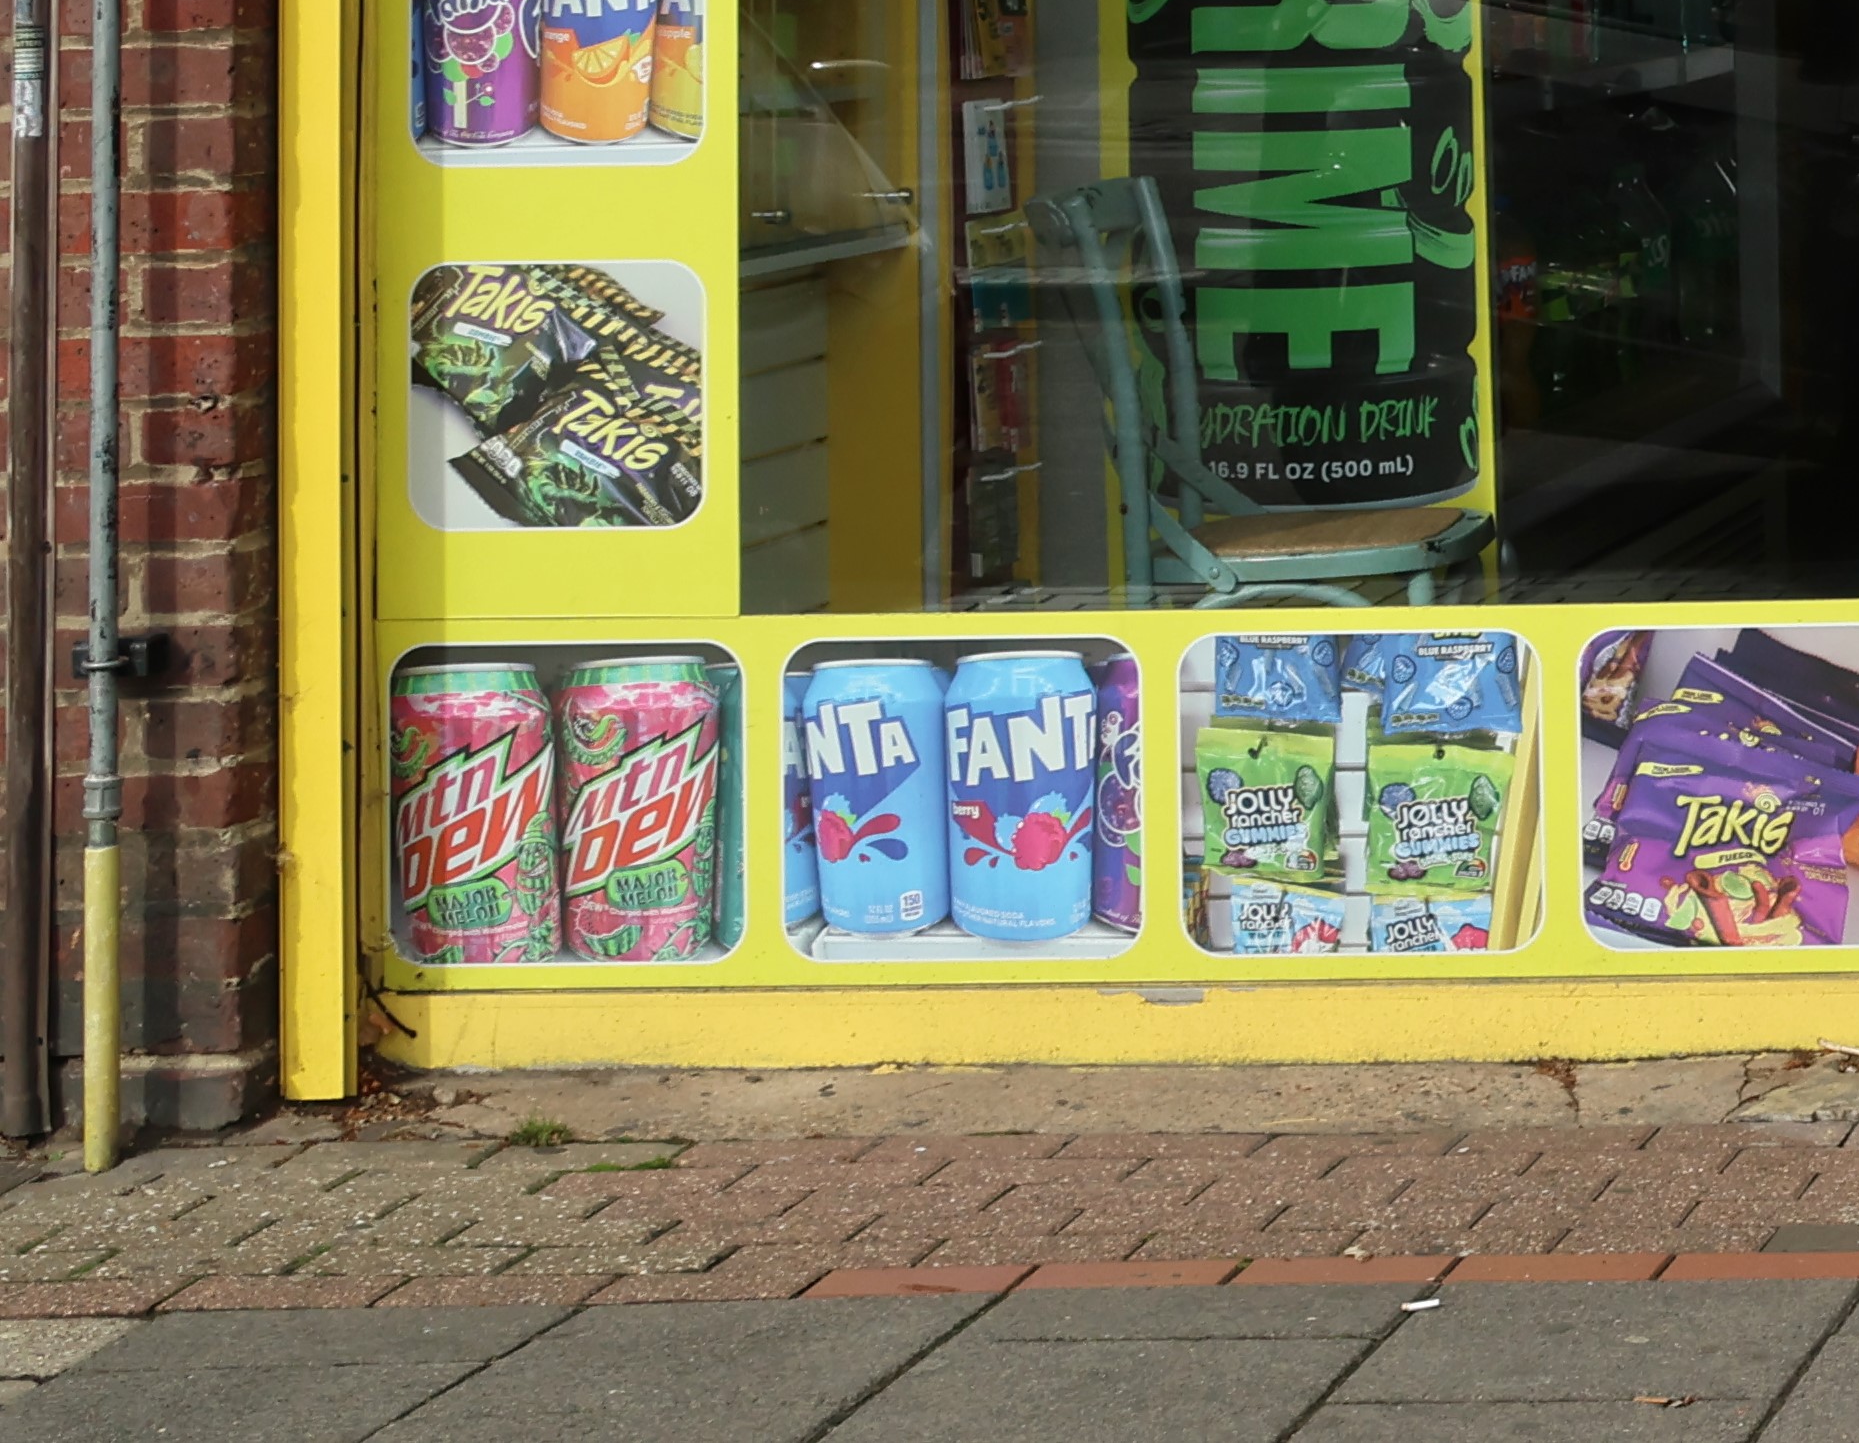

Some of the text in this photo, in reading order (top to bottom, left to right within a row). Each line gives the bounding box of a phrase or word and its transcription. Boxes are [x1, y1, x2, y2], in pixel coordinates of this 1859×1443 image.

[445, 265, 555, 333] Takis
[552, 390, 669, 471] Takis
[1200, 394, 1440, 449] YDRATION DRINK
[1208, 455, 1415, 483] 16.9 FL OZ (500 mL)
[1418, 643, 1494, 656] BLUE RASPBERRY
[803, 699, 916, 780] NTA
[1226, 787, 1296, 816] JOLLY
[1398, 799, 1470, 829] JOLLY
[1674, 792, 1794, 857] Takis
[1718, 851, 1754, 864] FUEGO
[615, 868, 677, 892] MAJOR
[435, 886, 498, 910] MAJOR
[621, 886, 679, 909] MELON
[902, 892, 921, 905] 150
